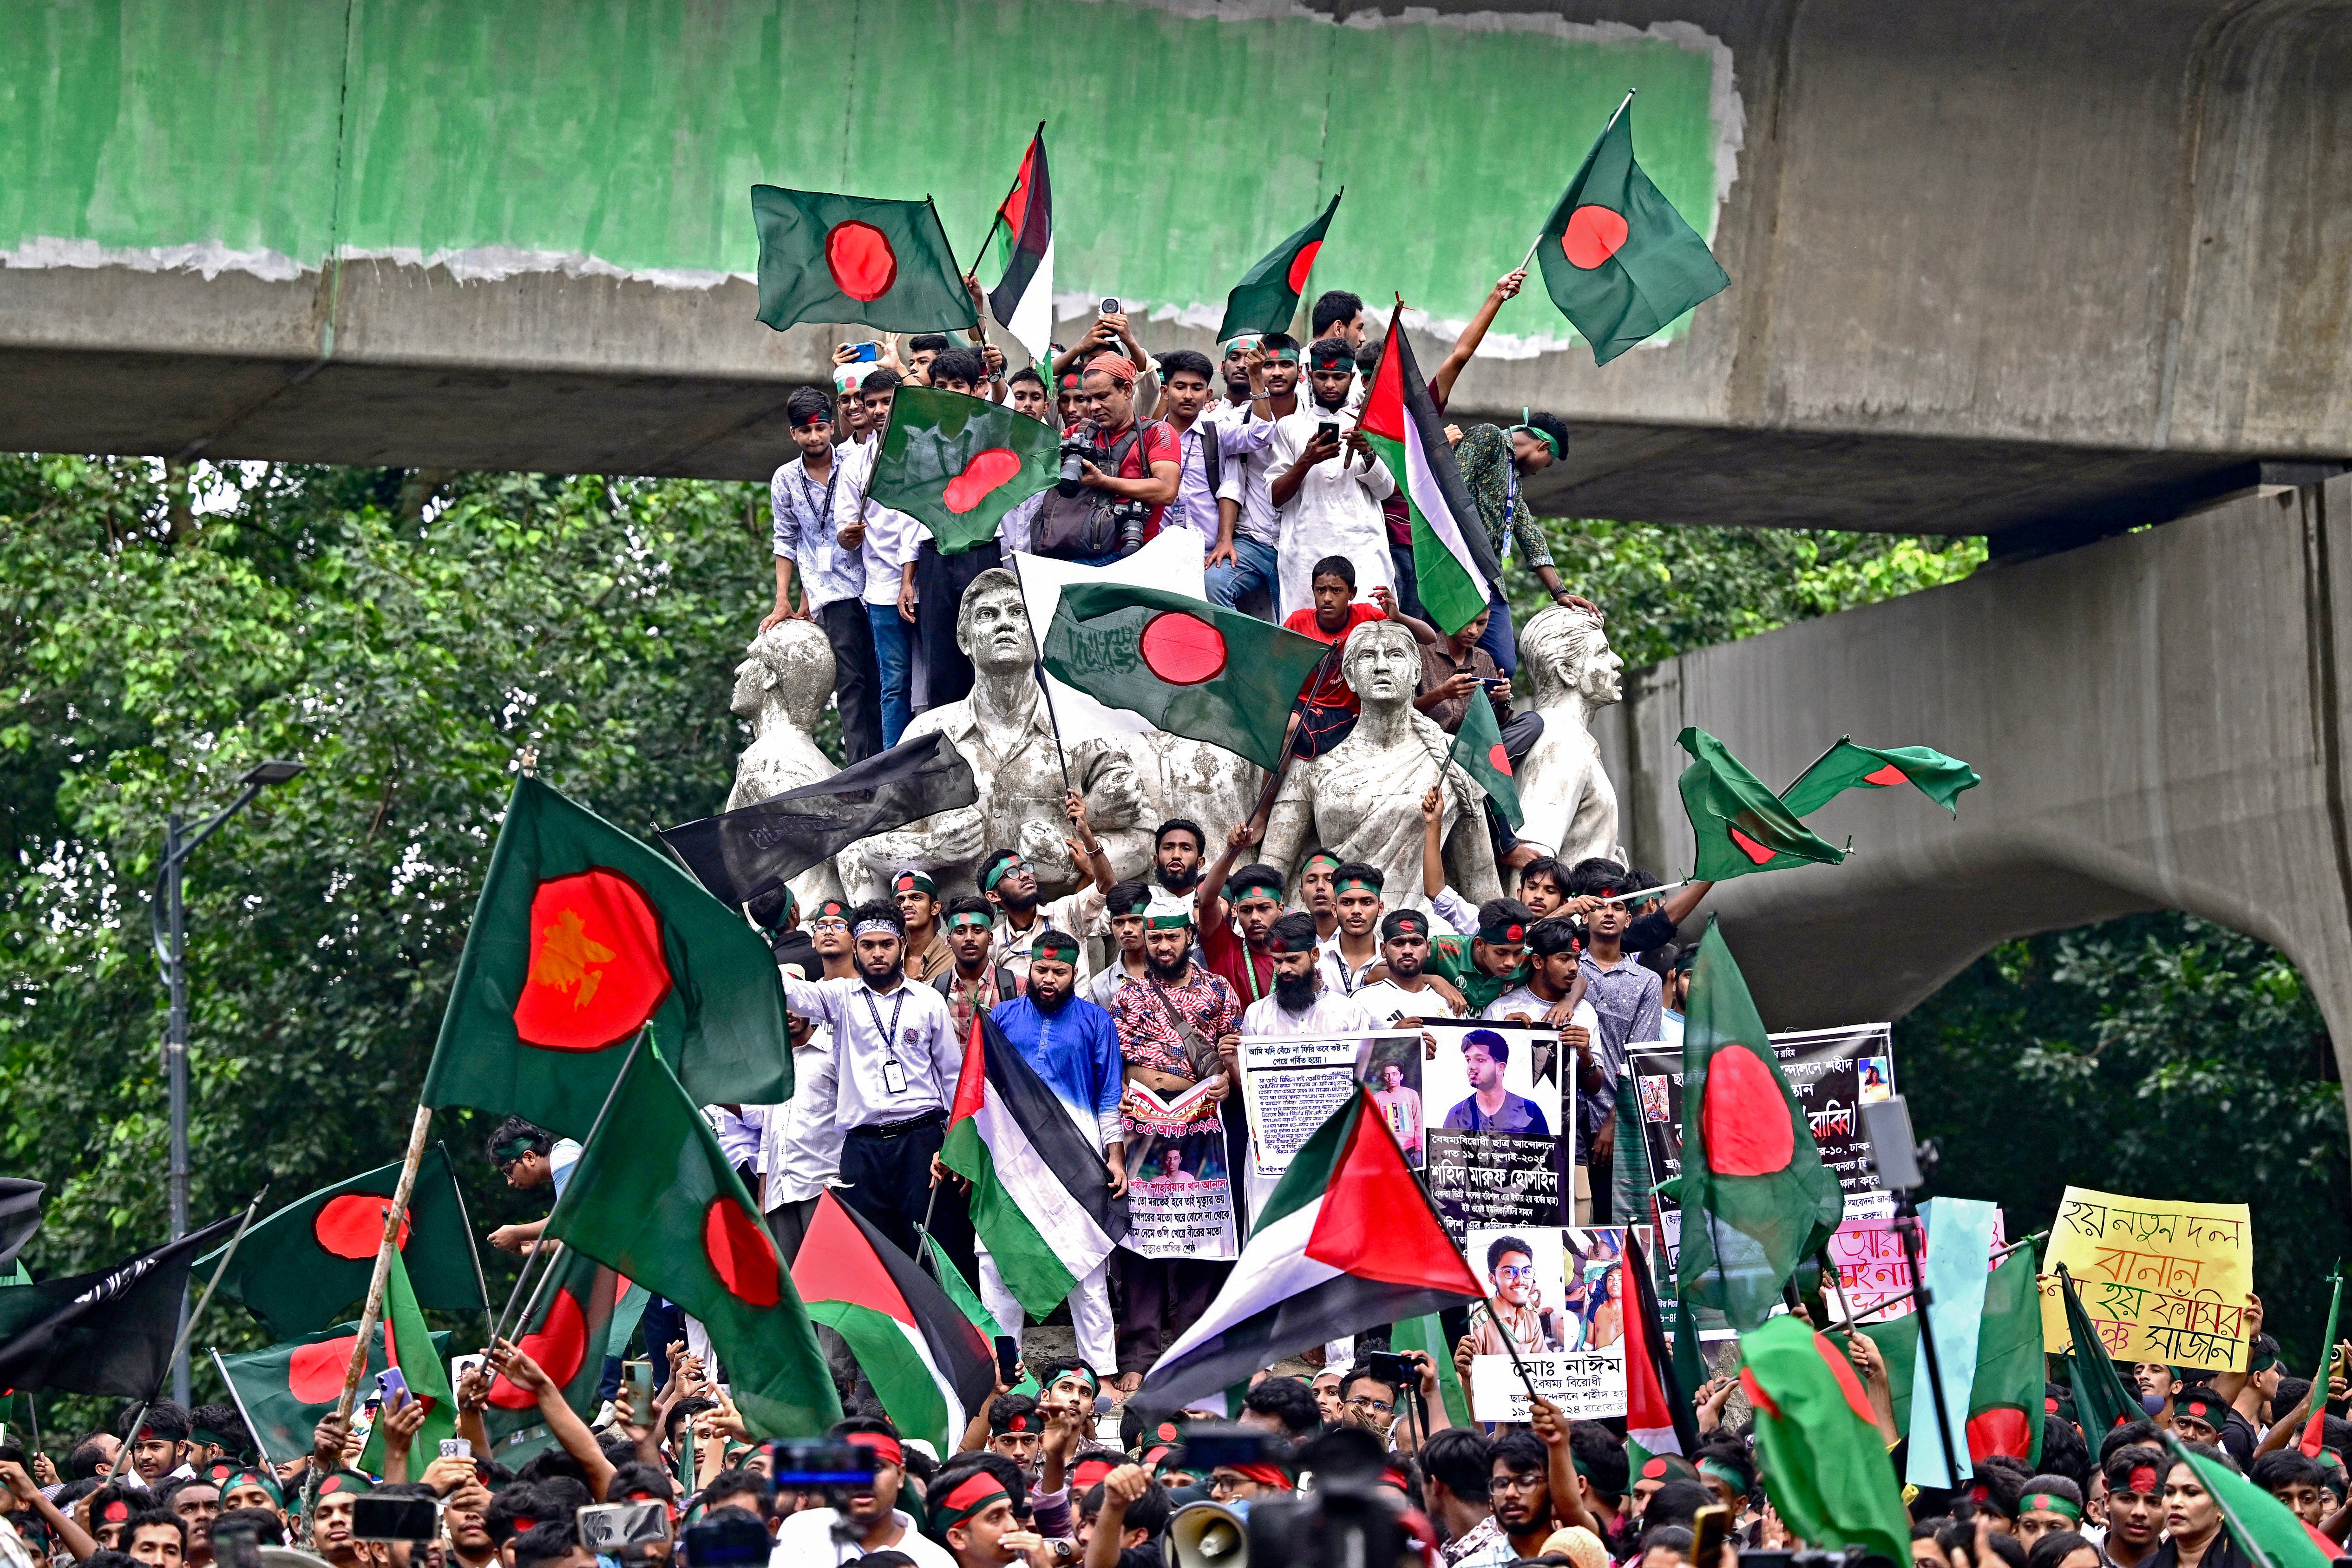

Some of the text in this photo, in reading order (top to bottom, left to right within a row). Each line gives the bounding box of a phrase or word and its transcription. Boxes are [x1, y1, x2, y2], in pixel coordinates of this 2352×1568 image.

[1248, 1047, 1263, 1056] আমি
[1264, 1046, 1275, 1055] যদি
[1278, 1046, 1291, 1055] বেঁচে
[1301, 1044, 1314, 1053] ফিরি
[1330, 1043, 1341, 1051] কষ্ট
[1290, 1056, 1305, 1064] গর্বিত
[1781, 1055, 1853, 1077] ন্দোলনে শহীদ
[1136, 1123, 1155, 1135] ০৫
[1155, 1121, 1187, 1138] আগষ্ট
[1431, 1134, 1555, 1150] বৈষম্যবিরোধী ছাত্র আন্দোলনে
[1491, 1150, 1546, 1163] জুলাই-২০২৪
[1430, 1159, 1559, 1192] শহিদ মারুফ হোসাইন
[1129, 1178, 1226, 1194] শহীদ শাহরিয়ার খান আনাস
[1138, 1197, 1146, 1206] তো
[1148, 1195, 1170, 1208] মরতেই
[1171, 1197, 1183, 1208] হবে
[1185, 1195, 1195, 1206] তাই
[1196, 1195, 1213, 1210] মৃত্যুর
[1215, 1195, 1225, 1204] ভয়
[1432, 1189, 1450, 1198] (একতা
[1465, 1191, 1481, 1200] কলেজ
[1482, 1190, 1500, 1201] বরিশাল
[1510, 1192, 1524, 1202] ইন্টার
[1533, 1194, 1545, 1204] বর্ষের
[1547, 1196, 1558, 1206] ছাত্র)
[1847, 1196, 1874, 1207] সমবেদনা
[1157, 1213, 1173, 1223] মতো
[1174, 1213, 1186, 1223] ঘরে
[1187, 1211, 1204, 1223] বোসে
[1205, 1210, 1212, 1221] না
[1214, 1210, 1230, 1221] থেকে
[1141, 1229, 1155, 1238] নেমে
[1157, 1226, 1170, 1238] গুলি
[1172, 1228, 1186, 1238] খেয়ে
[1187, 1225, 1205, 1238] বীরের
[1206, 1225, 1222, 1237] মতো
[2063, 1201, 2244, 1253] হয় নতুন দল
[1163, 1241, 1181, 1253] অধিক
[1183, 1240, 1196, 1253] শ্রেষ্ঠ
[2095, 1247, 2206, 1288] বানান
[2096, 1282, 2152, 1320] হয়
[2150, 1287, 2244, 1338] ফাঁসির
[2144, 1325, 2244, 1368] সাজান
[1563, 1354, 1622, 1376] নাঈম
[1532, 1375, 1601, 1389] বৈষম্য বিরোধী
[1582, 1388, 1608, 1400] শহীদ
